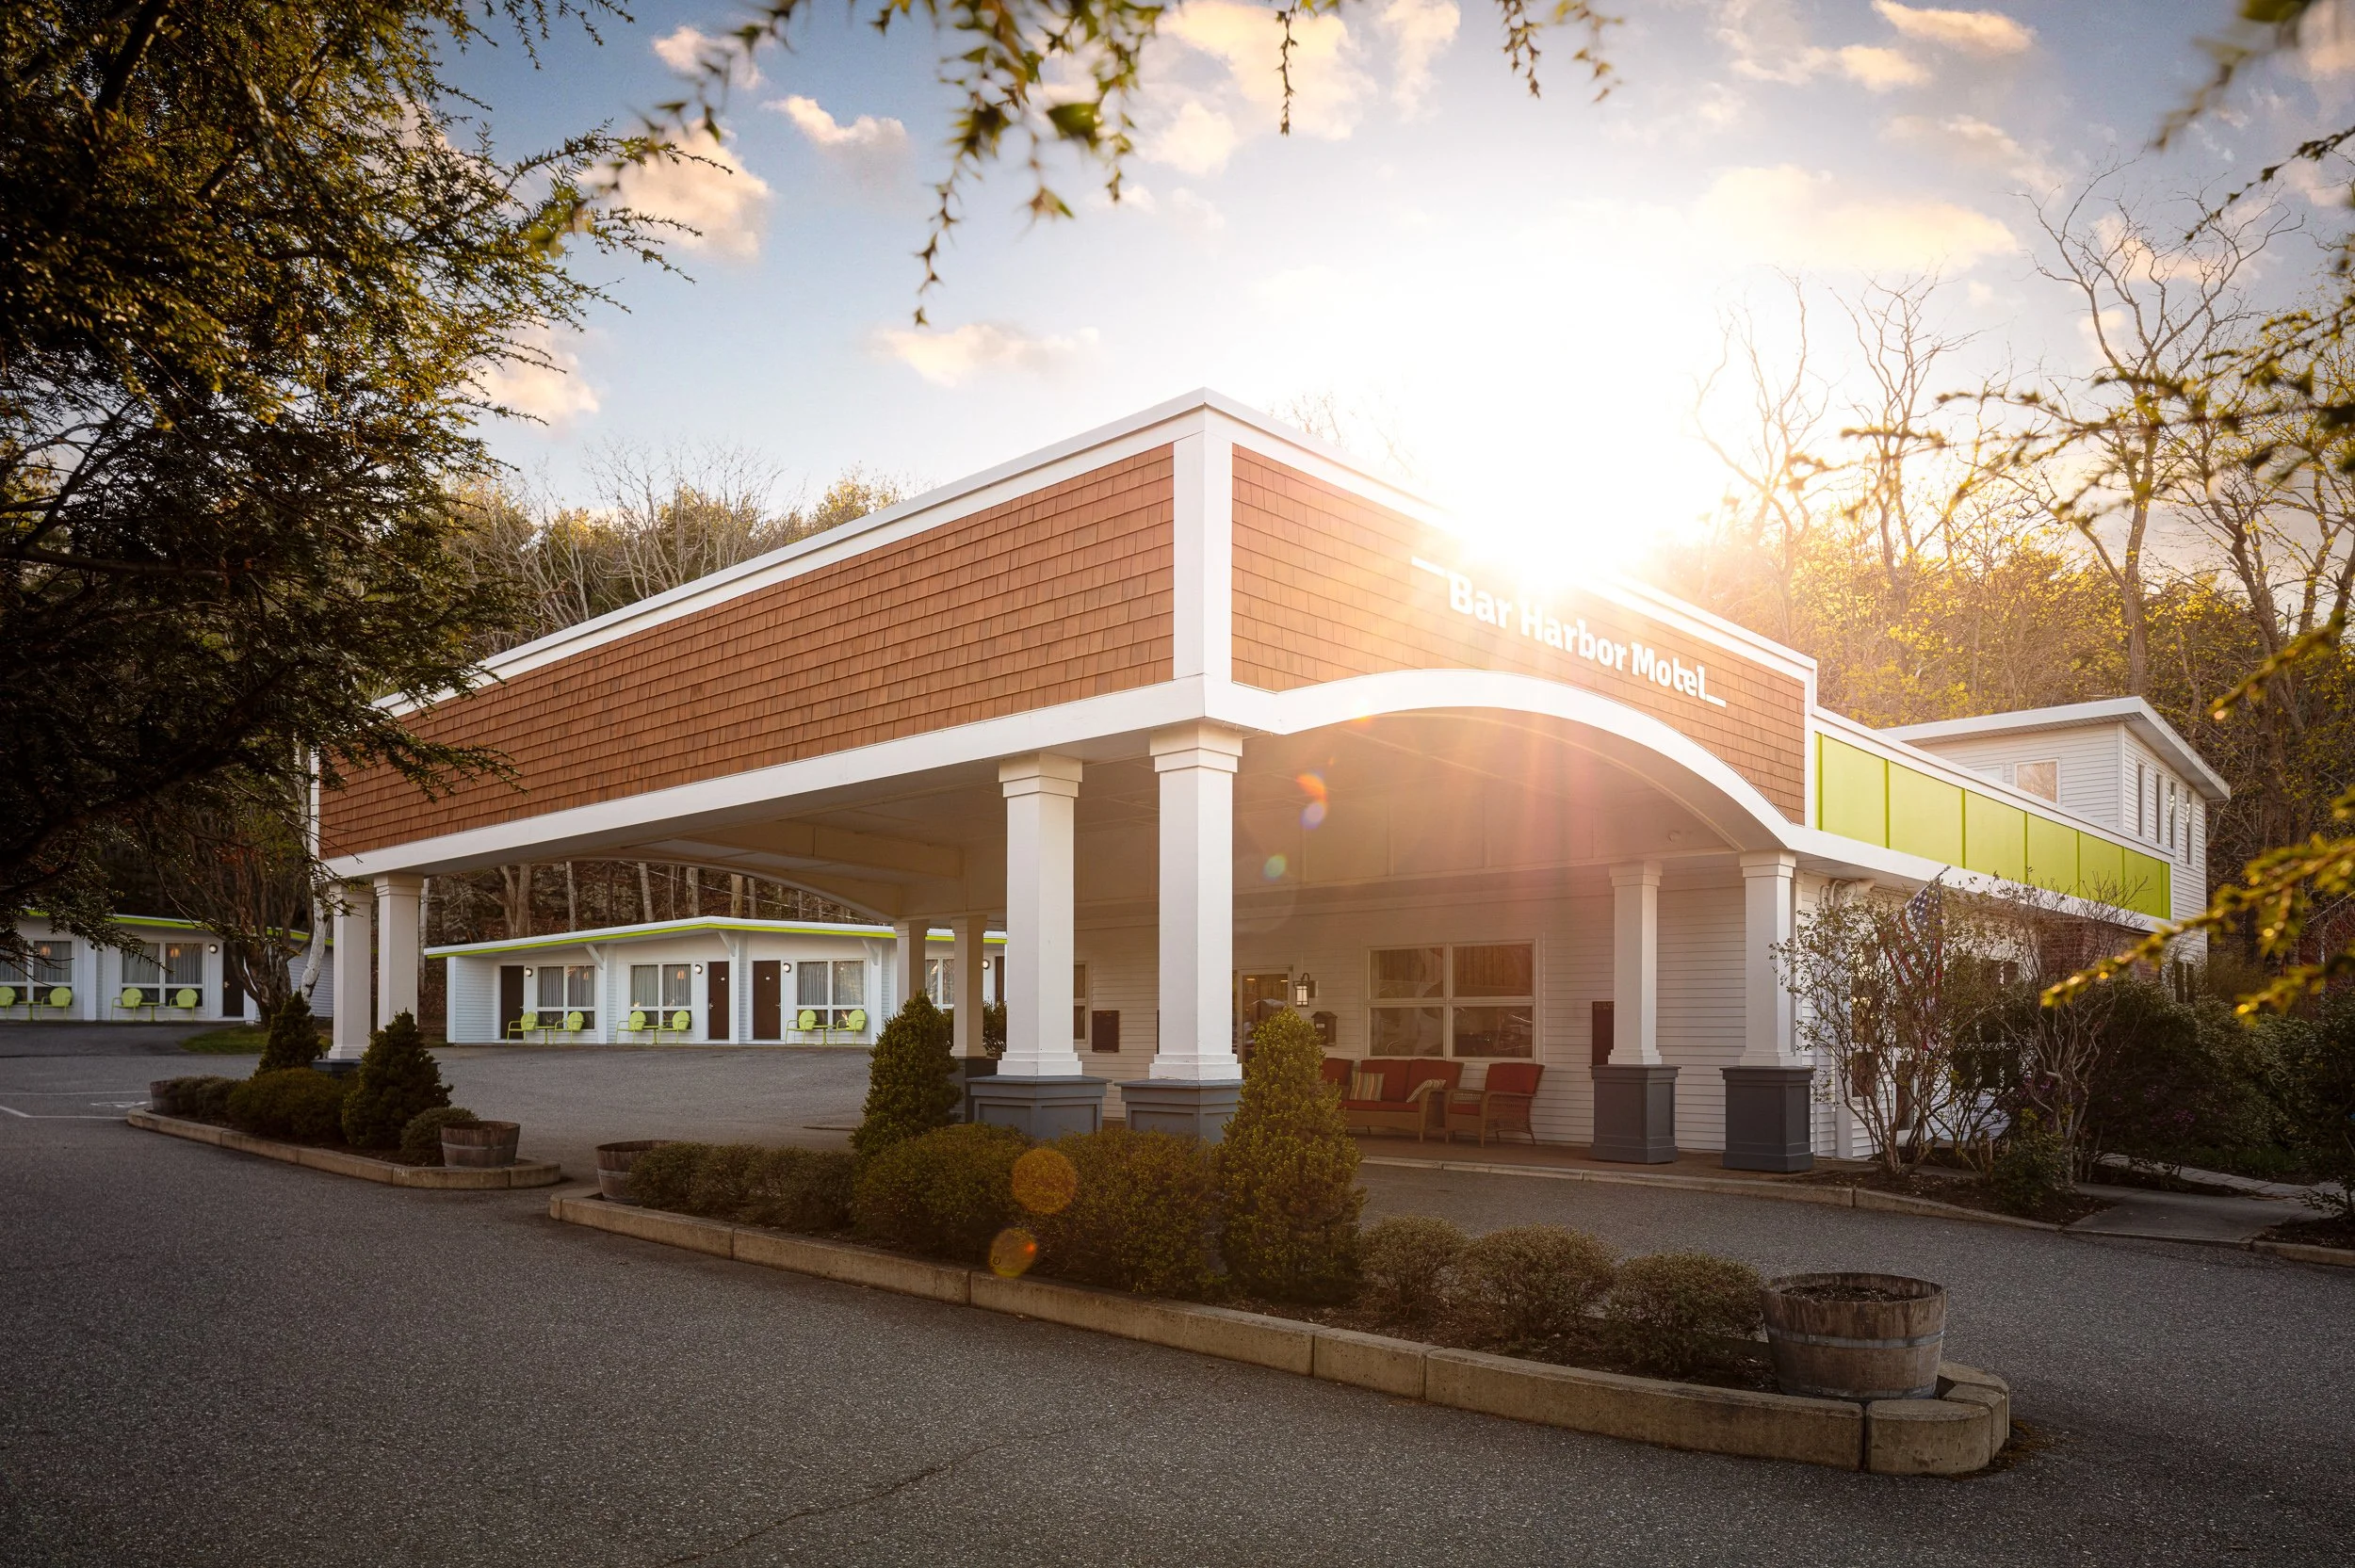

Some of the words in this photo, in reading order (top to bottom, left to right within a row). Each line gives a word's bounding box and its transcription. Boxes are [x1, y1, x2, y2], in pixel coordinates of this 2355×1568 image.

[1448, 574, 1512, 628] Bar
[1519, 602, 1627, 671] Harbor
[1632, 642, 1706, 700] Motel
